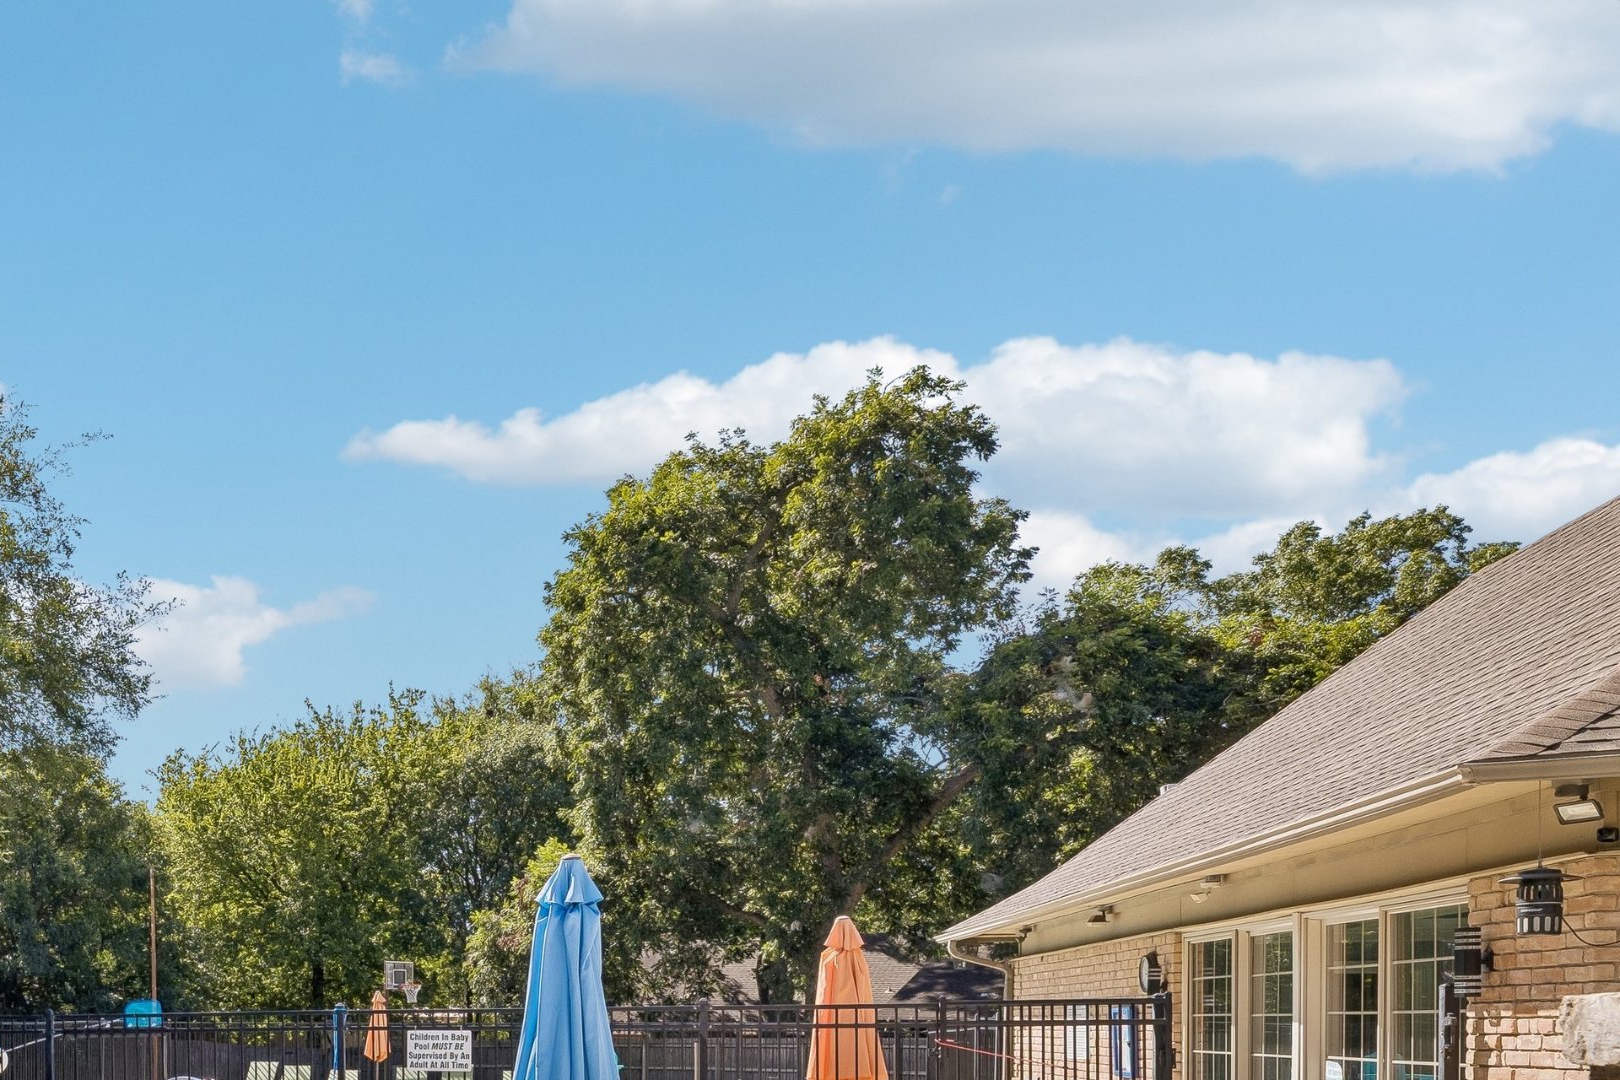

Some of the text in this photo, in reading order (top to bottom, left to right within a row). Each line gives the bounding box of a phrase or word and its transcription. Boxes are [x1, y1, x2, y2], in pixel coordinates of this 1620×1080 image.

[409, 1033, 469, 1042] Children In Baby
[414, 1042, 465, 1050] Pool MUST BE
[408, 1051, 470, 1060] Supervised By An
[409, 1061, 469, 1069] Adult At All Time
